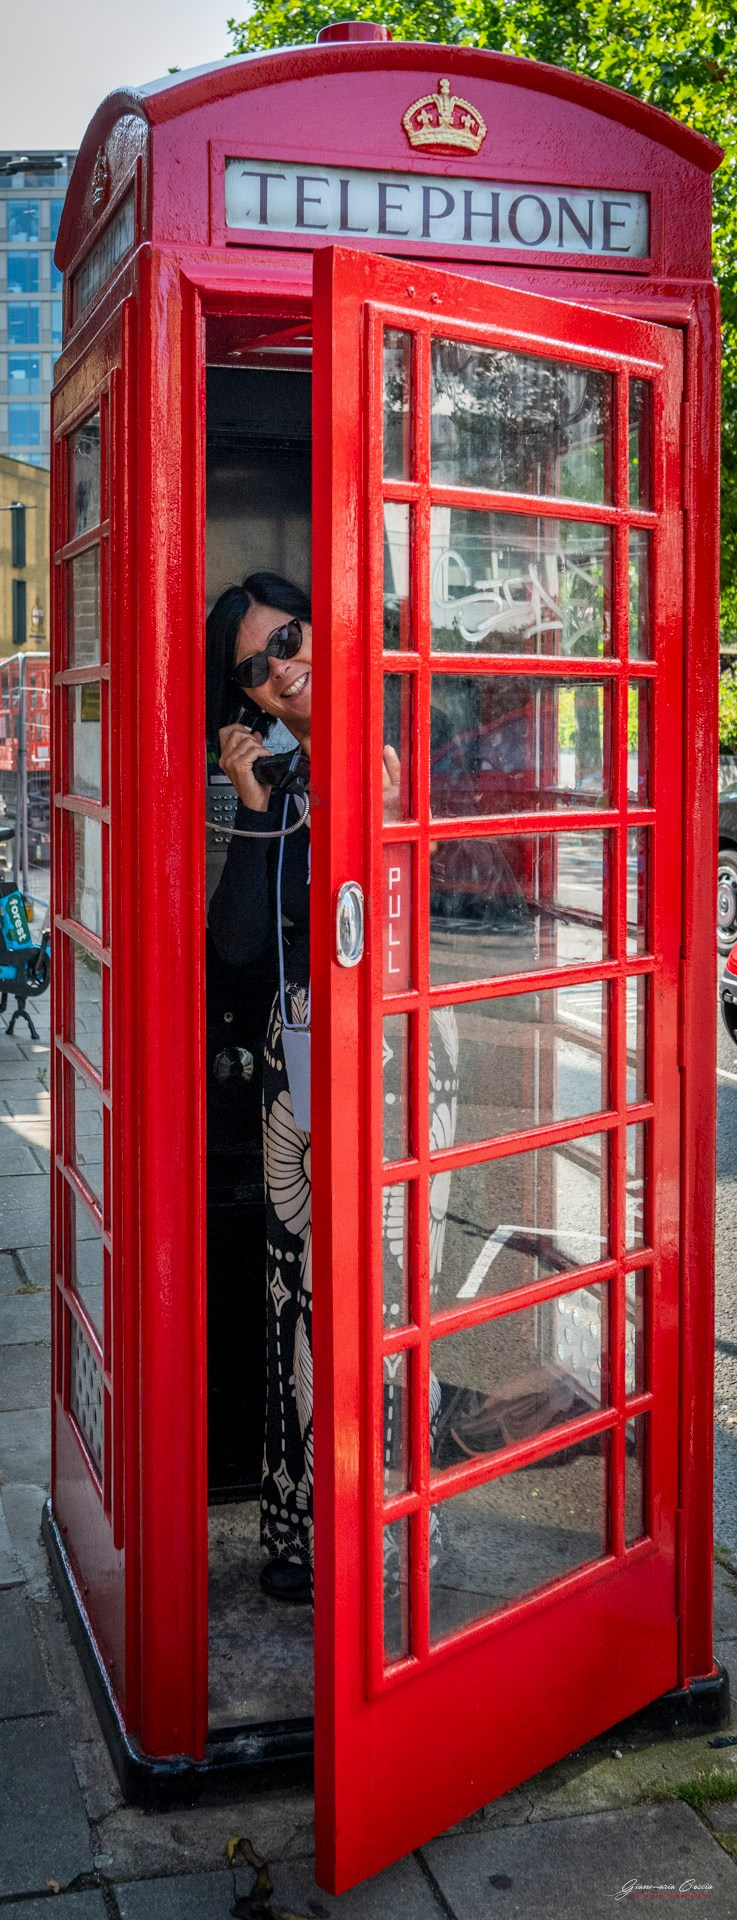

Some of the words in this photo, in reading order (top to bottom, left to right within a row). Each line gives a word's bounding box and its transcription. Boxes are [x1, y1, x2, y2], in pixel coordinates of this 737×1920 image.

[241, 171, 632, 253] TELEPHONE
[9, 898, 27, 943] forest
[388, 867, 401, 974] PULL
